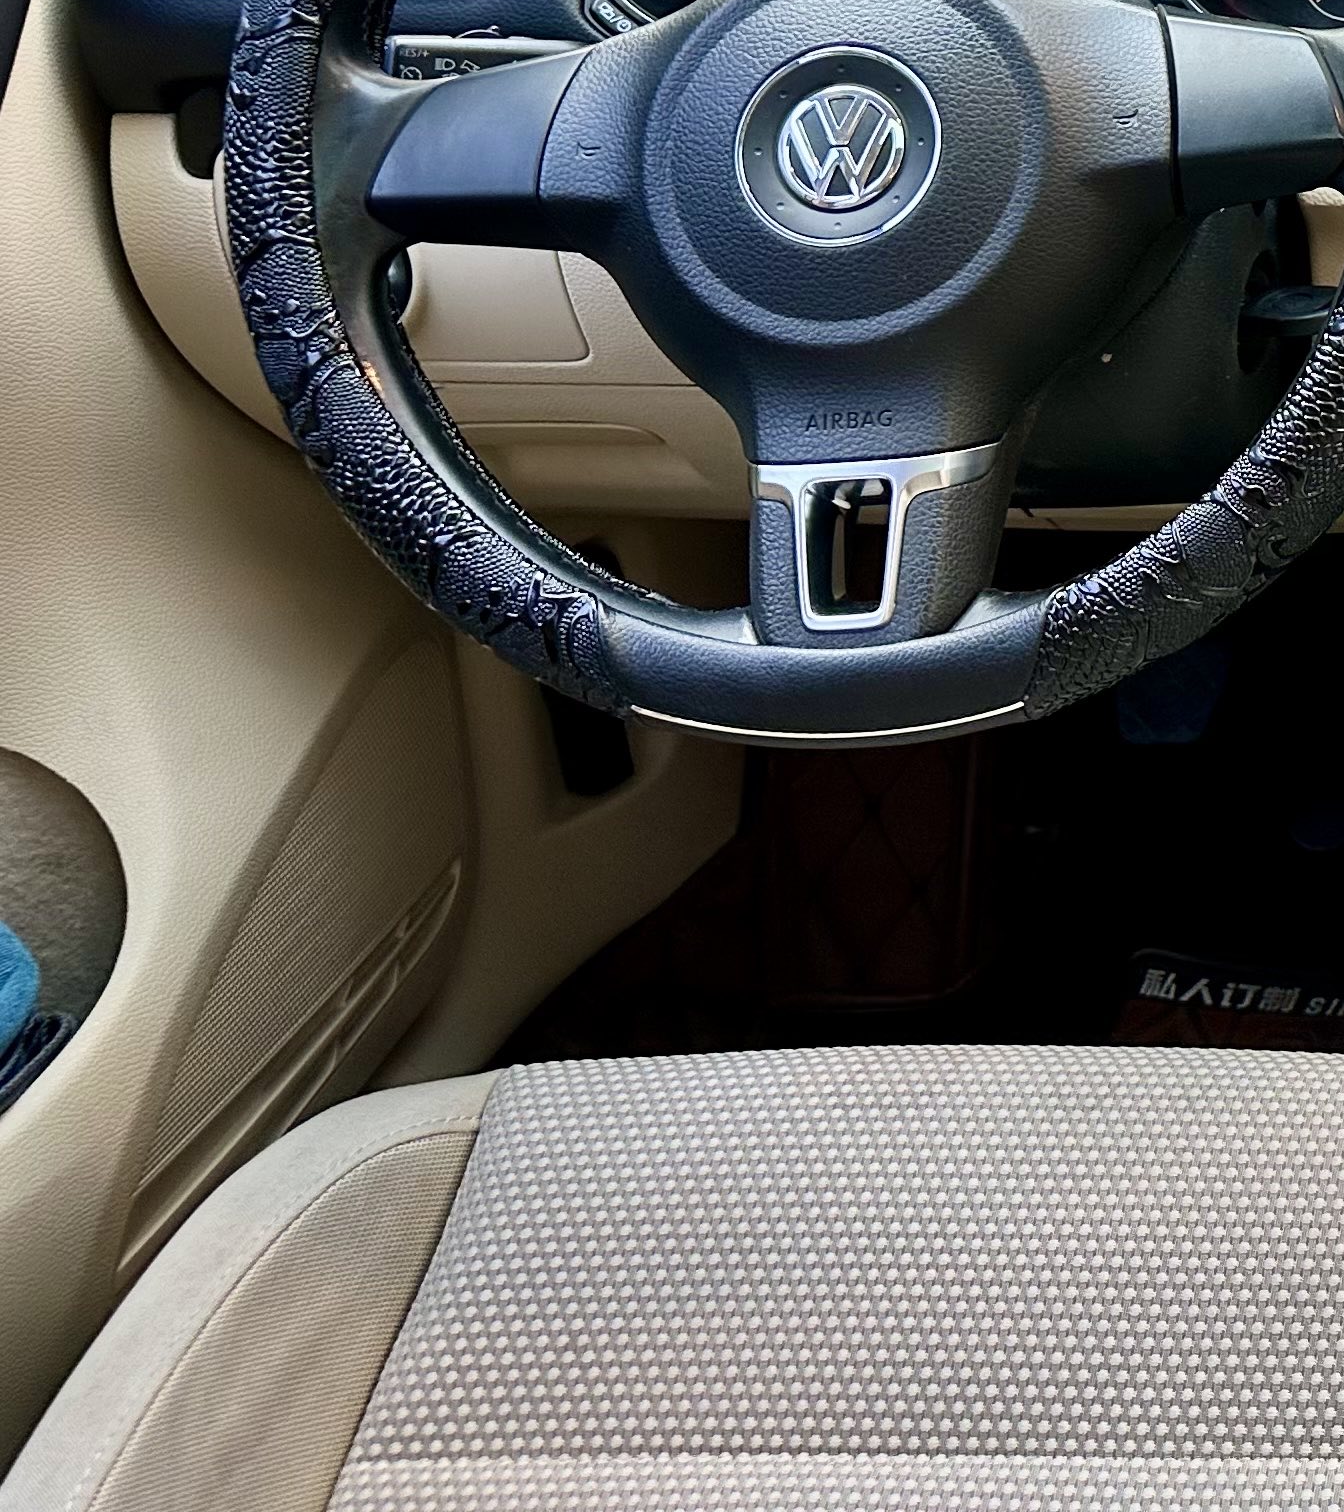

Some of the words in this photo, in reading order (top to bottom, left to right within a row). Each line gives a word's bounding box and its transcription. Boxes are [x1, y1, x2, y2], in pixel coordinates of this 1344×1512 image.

[805, 408, 894, 433] AIRBAG
[1138, 968, 1299, 1014] 私人订制
